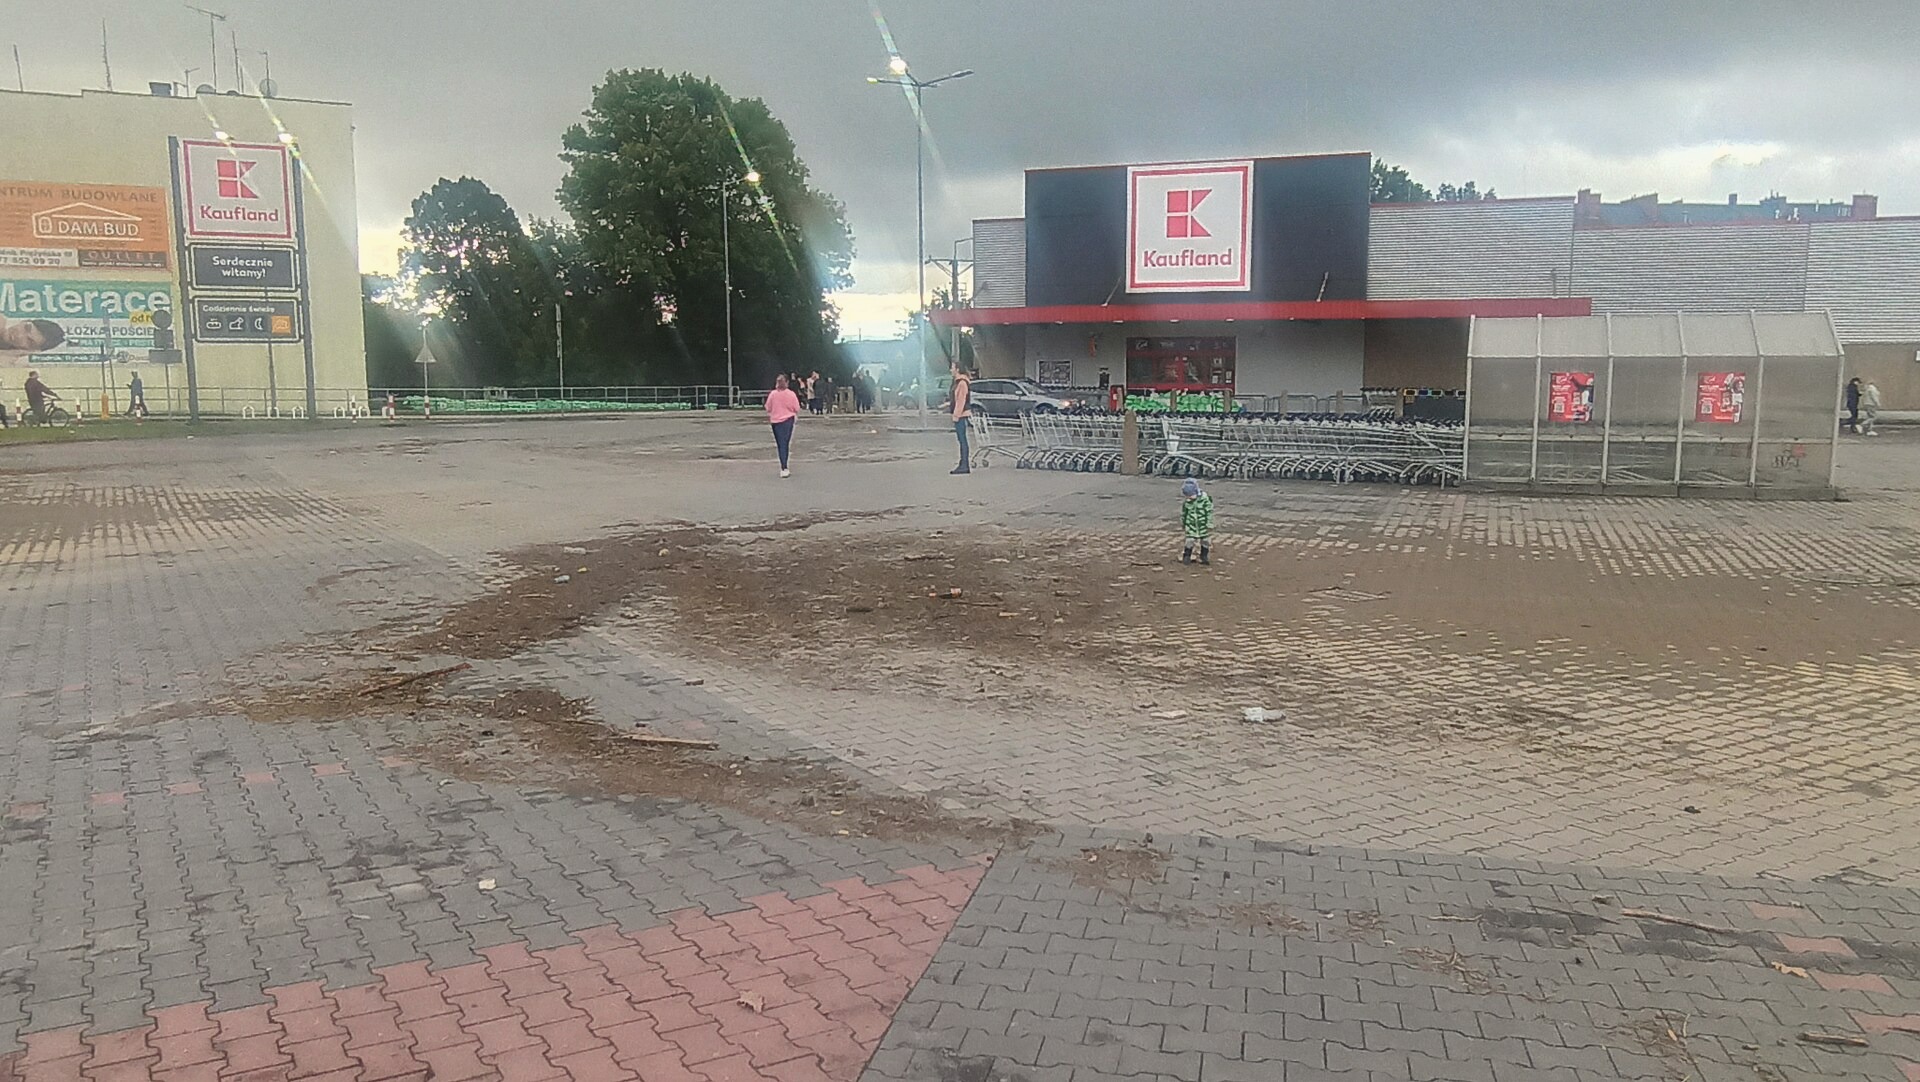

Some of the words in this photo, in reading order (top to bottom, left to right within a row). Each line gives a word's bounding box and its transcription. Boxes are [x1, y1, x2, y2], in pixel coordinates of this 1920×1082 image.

[62, 188, 158, 203] BUDOWLANE
[200, 205, 279, 222] Kaufland
[212, 255, 273, 268] Serdecznie
[1143, 247, 1232, 268] Kaufland
[221, 267, 266, 280] witamy!
[0, 282, 171, 313] Materace
